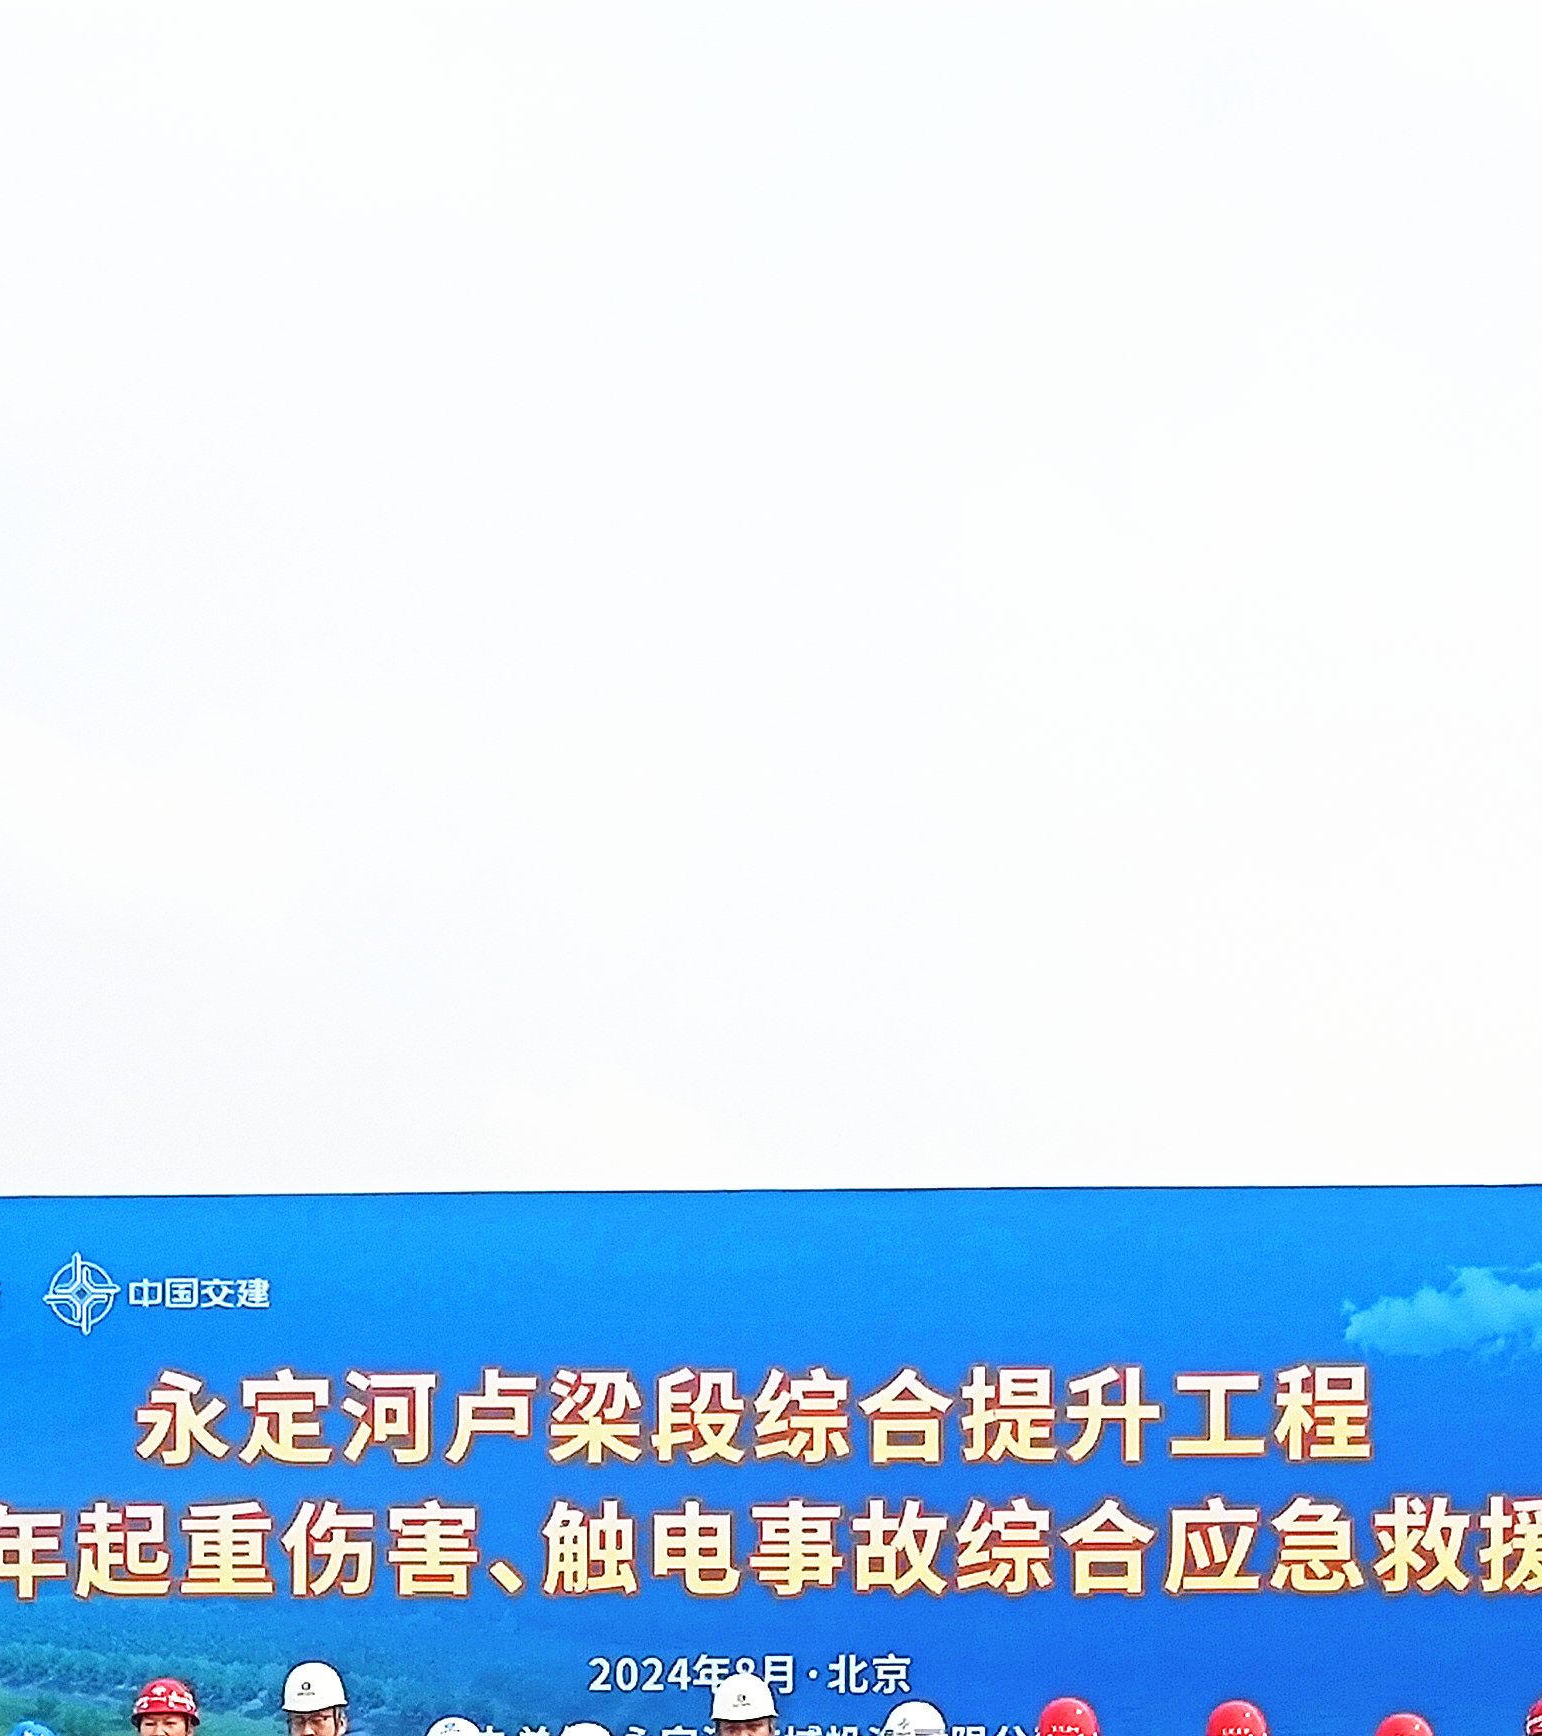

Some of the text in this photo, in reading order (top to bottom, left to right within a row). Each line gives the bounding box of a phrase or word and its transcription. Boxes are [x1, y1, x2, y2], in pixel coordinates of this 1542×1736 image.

[128, 1276, 272, 1310] 中国交建
[135, 1364, 1374, 1468] 永定河卢梁段综合提升工程
